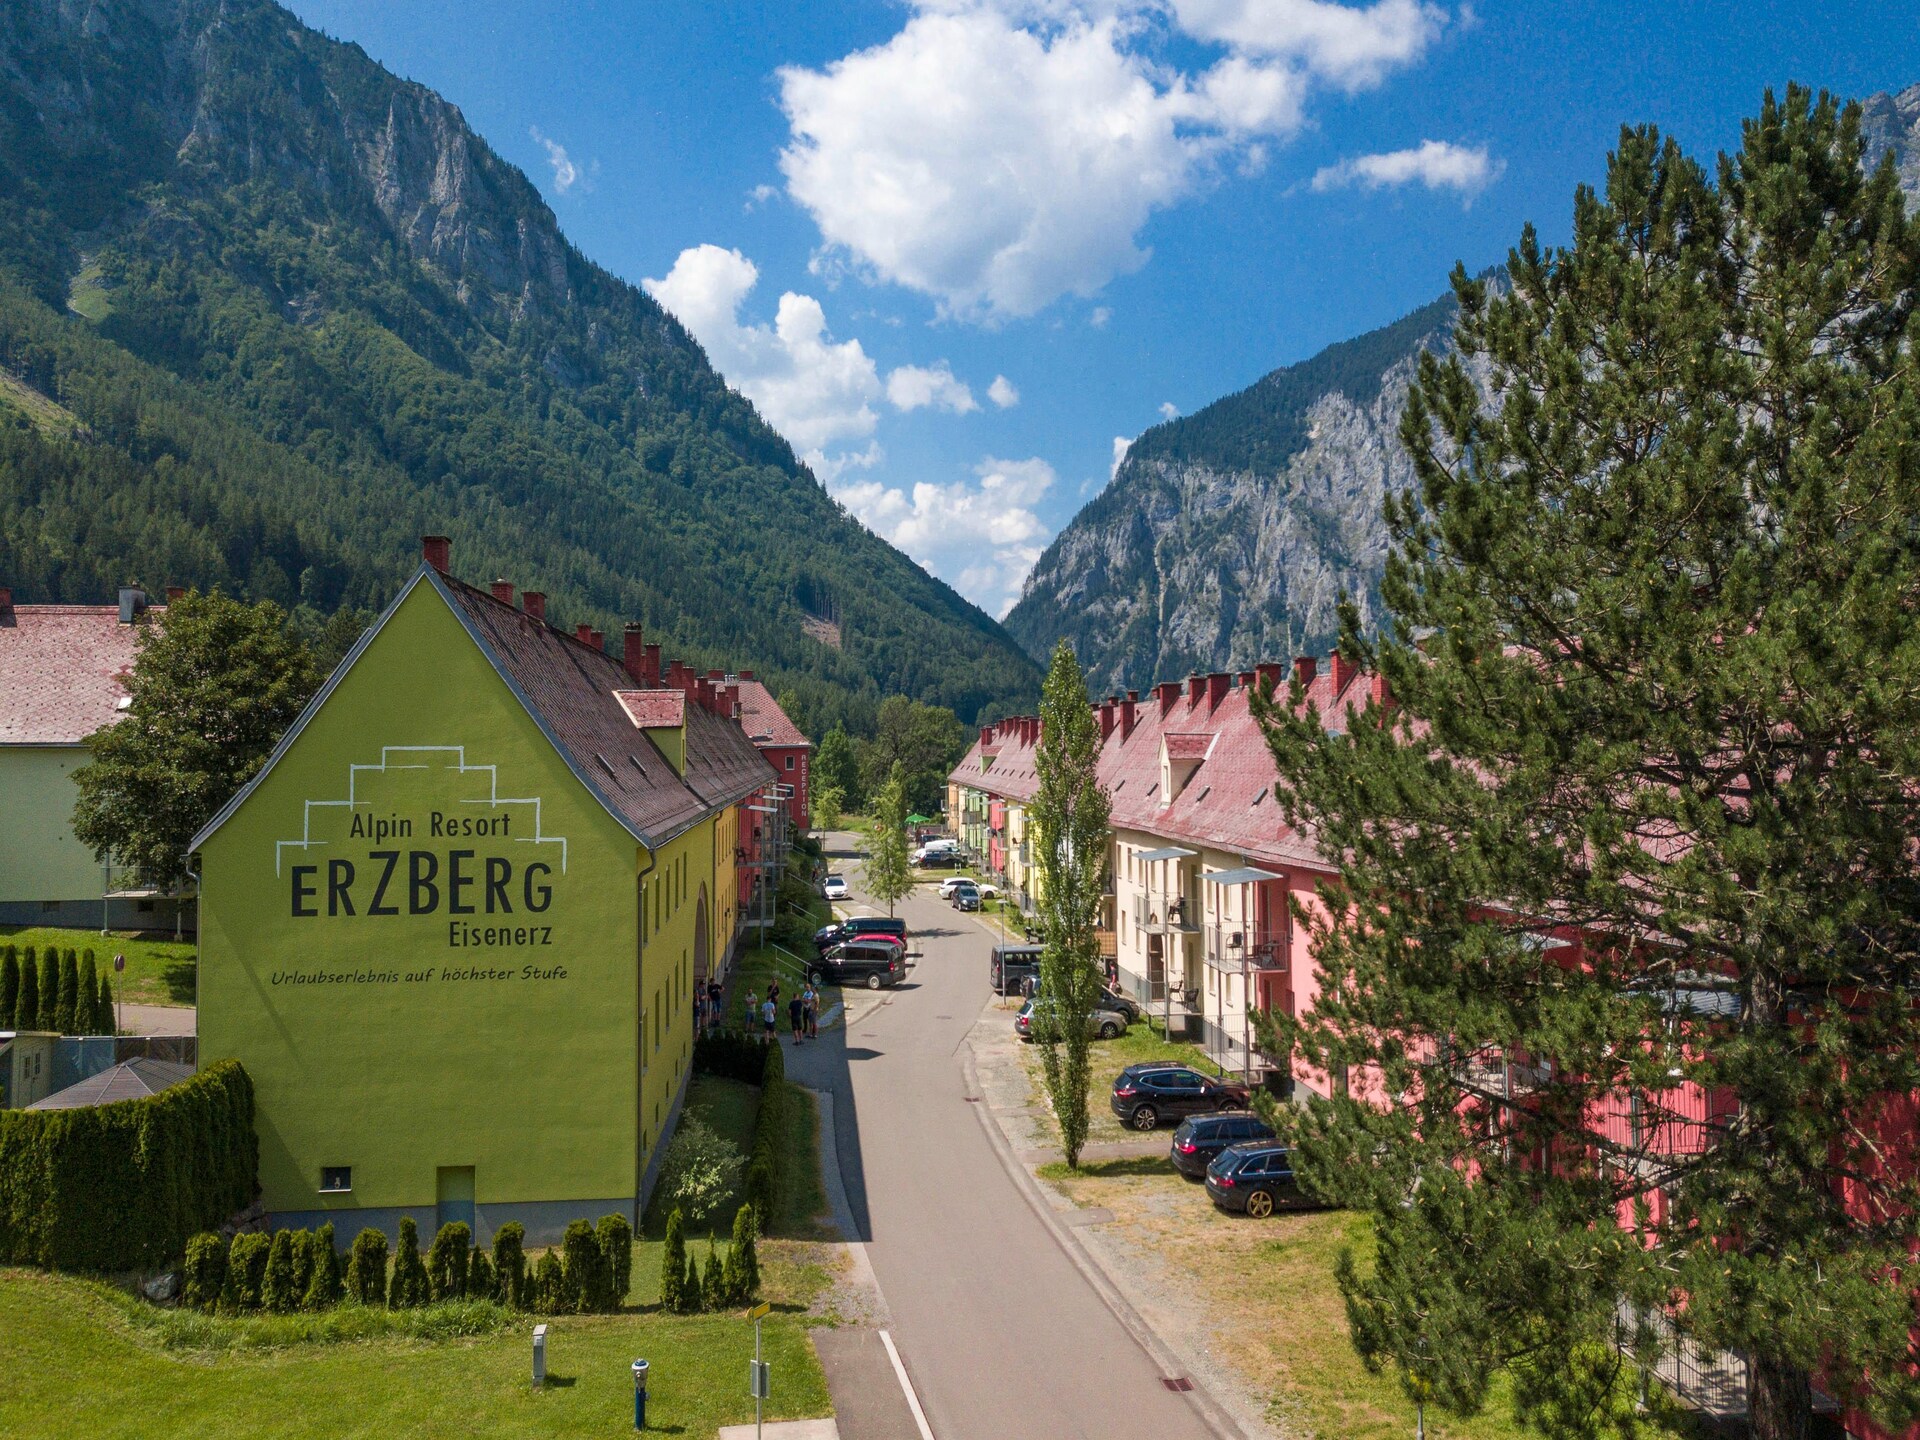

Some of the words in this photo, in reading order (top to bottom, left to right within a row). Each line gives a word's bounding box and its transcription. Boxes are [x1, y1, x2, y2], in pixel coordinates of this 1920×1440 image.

[349, 813, 412, 846] Alpin
[430, 811, 511, 837] Resort
[291, 850, 552, 917] ERZBERG
[449, 921, 553, 947] Eisenerz
[271, 968, 399, 986] Urlaubserlebnis
[404, 967, 436, 983] auf
[440, 966, 515, 982] höchster
[520, 965, 568, 980] Stufe
